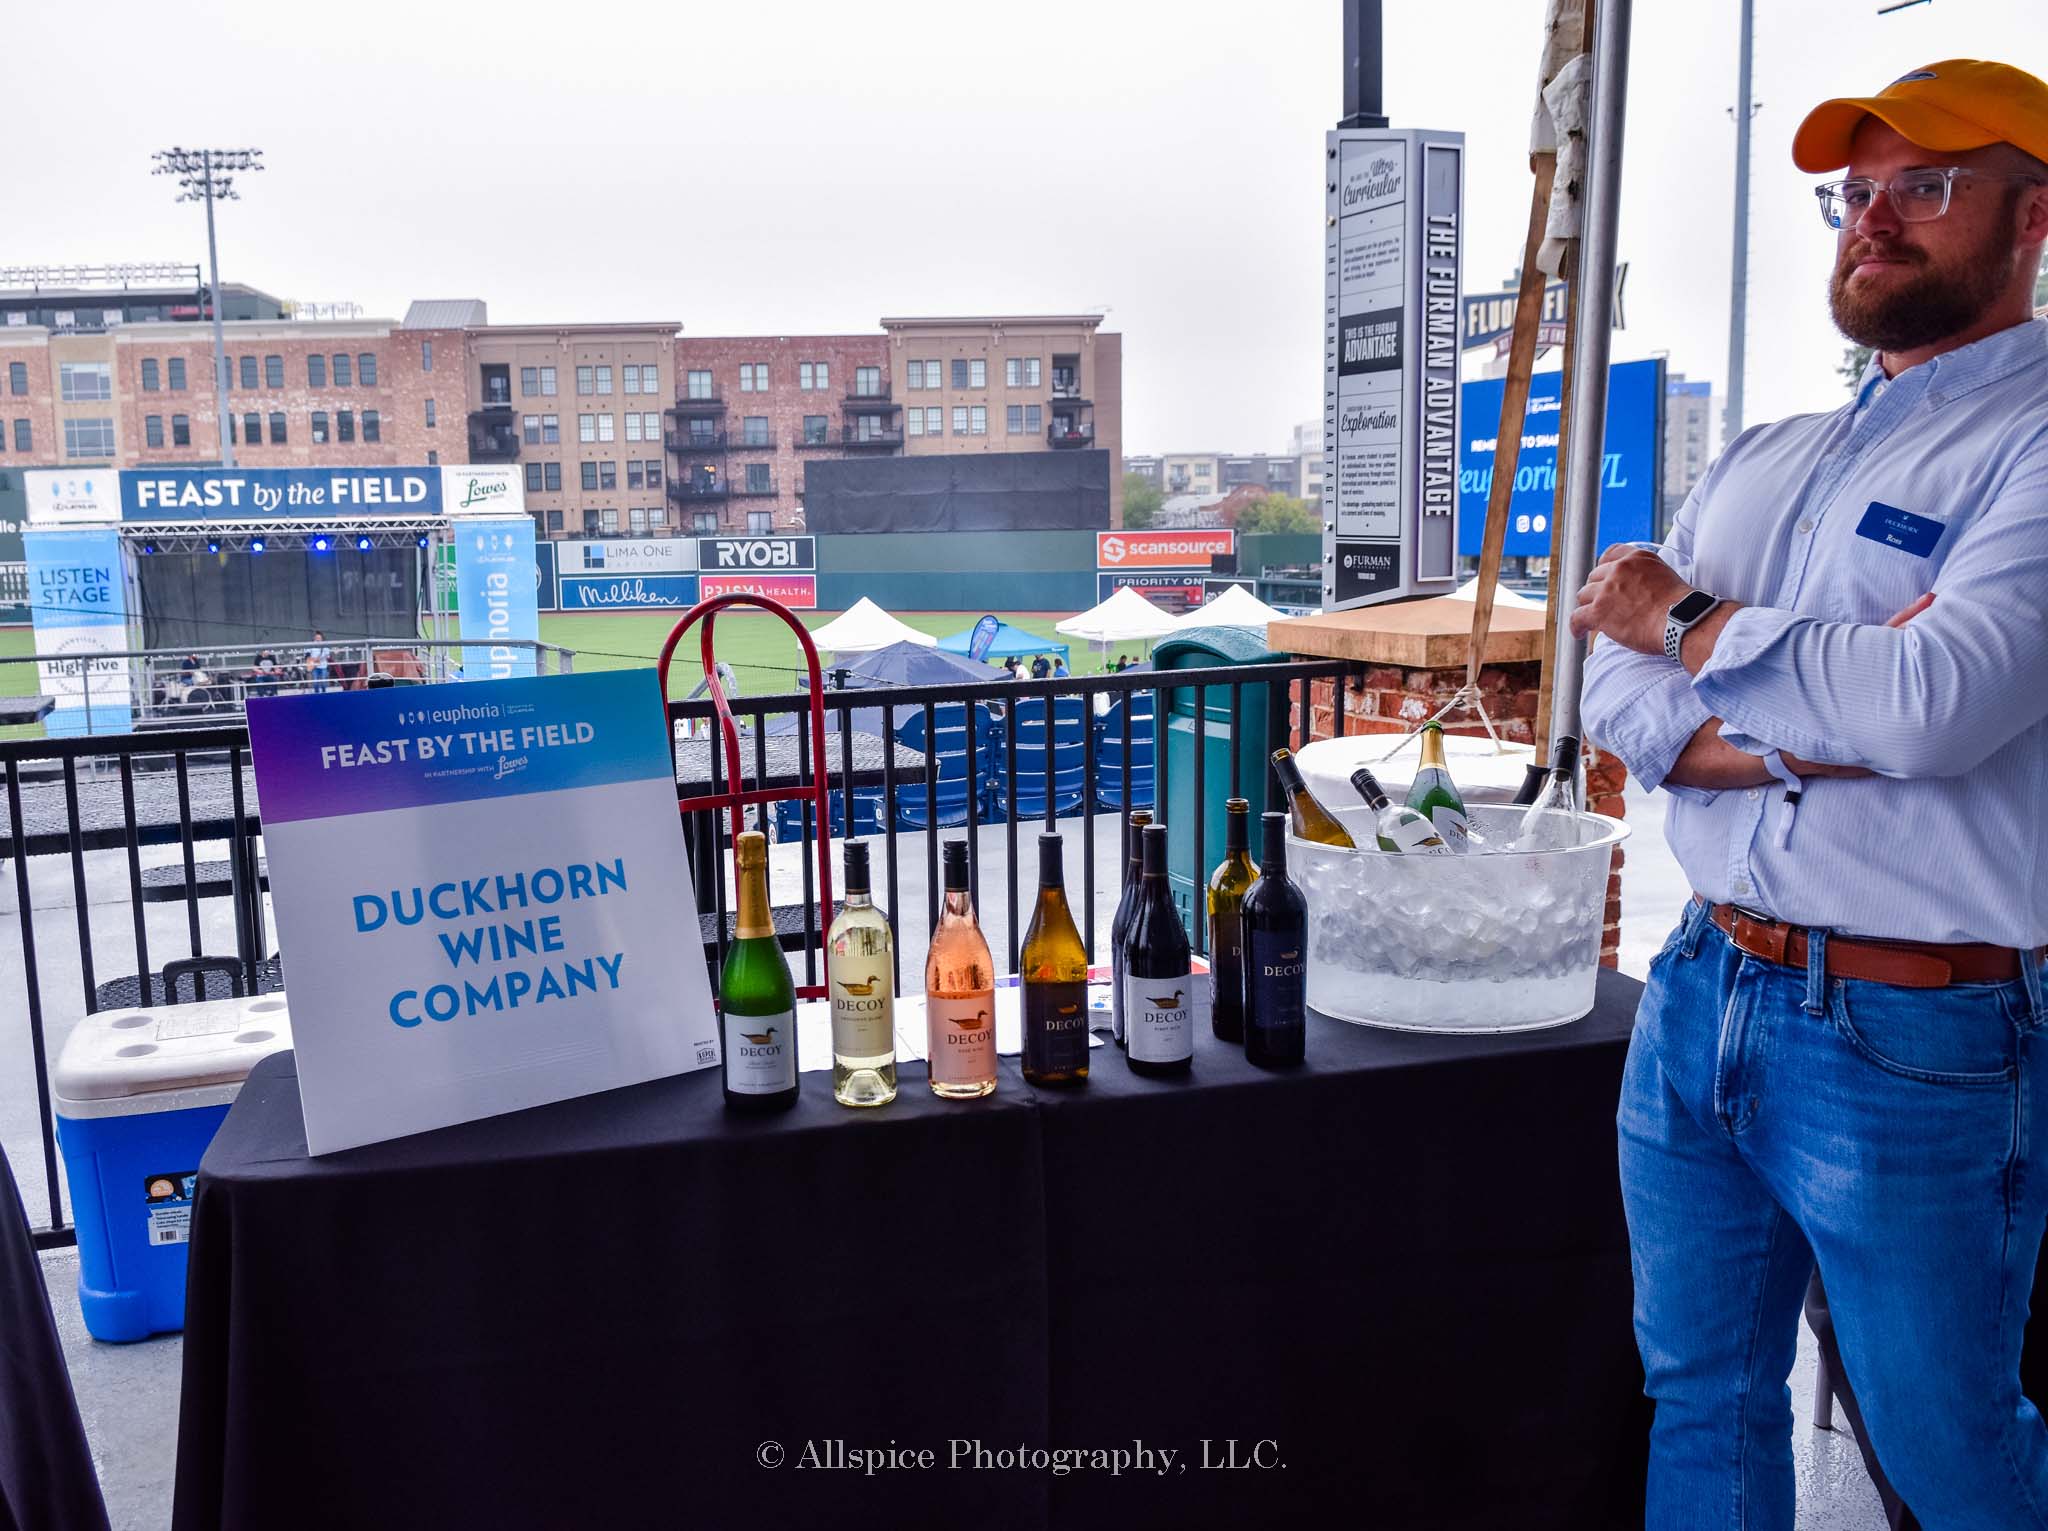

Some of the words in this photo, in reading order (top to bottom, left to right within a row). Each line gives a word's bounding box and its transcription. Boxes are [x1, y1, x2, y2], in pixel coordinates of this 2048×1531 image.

[1343, 172, 1401, 207] Curricular
[1428, 214, 1456, 257] THE
[1427, 267, 1456, 368] FURMAN
[1468, 298, 1519, 337] FLUO
[1344, 333, 1397, 363] ADVANTAGE
[1341, 410, 1397, 438] Exploration
[1325, 391, 1335, 505] ADVANTAGE
[1424, 376, 1454, 517] ADVANTAGE
[1520, 435, 1536, 449] TO
[136, 478, 245, 508] FEAST
[253, 482, 282, 512] by
[287, 482, 325, 505] the
[330, 477, 428, 504] FIELD
[459, 478, 507, 508] Lowes
[606, 546, 639, 558] LIMA
[643, 544, 673, 557] ONE
[716, 541, 798, 566] RYOBI
[1129, 541, 1227, 556] scansource
[1352, 555, 1391, 566] FURMAN
[39, 567, 110, 586] LISTEN
[1118, 577, 1179, 586] PRIORITY
[1183, 577, 1202, 585] ON
[43, 586, 111, 605] STAGE
[578, 578, 678, 607] Milliken
[480, 571, 519, 680] uphoria
[432, 703, 500, 725] euphoria
[320, 738, 410, 769] FEAST
[417, 734, 451, 759] BY
[459, 728, 516, 755] THE
[520, 721, 595, 748] FIELD
[433, 767, 477, 778] PARTNERSHIP
[477, 765, 495, 774] WITH
[493, 755, 529, 780] Lowes
[352, 857, 628, 933] DUCKHORN
[437, 915, 565, 969] WINE
[1263, 963, 1305, 977] DECOY
[389, 952, 625, 1029] COMPANY
[836, 997, 886, 1012] DECOY
[1144, 1009, 1188, 1023] DECOY
[1046, 1016, 1085, 1031] DECOY
[947, 1028, 993, 1045] DECOY
[740, 1044, 782, 1057] DECOY
